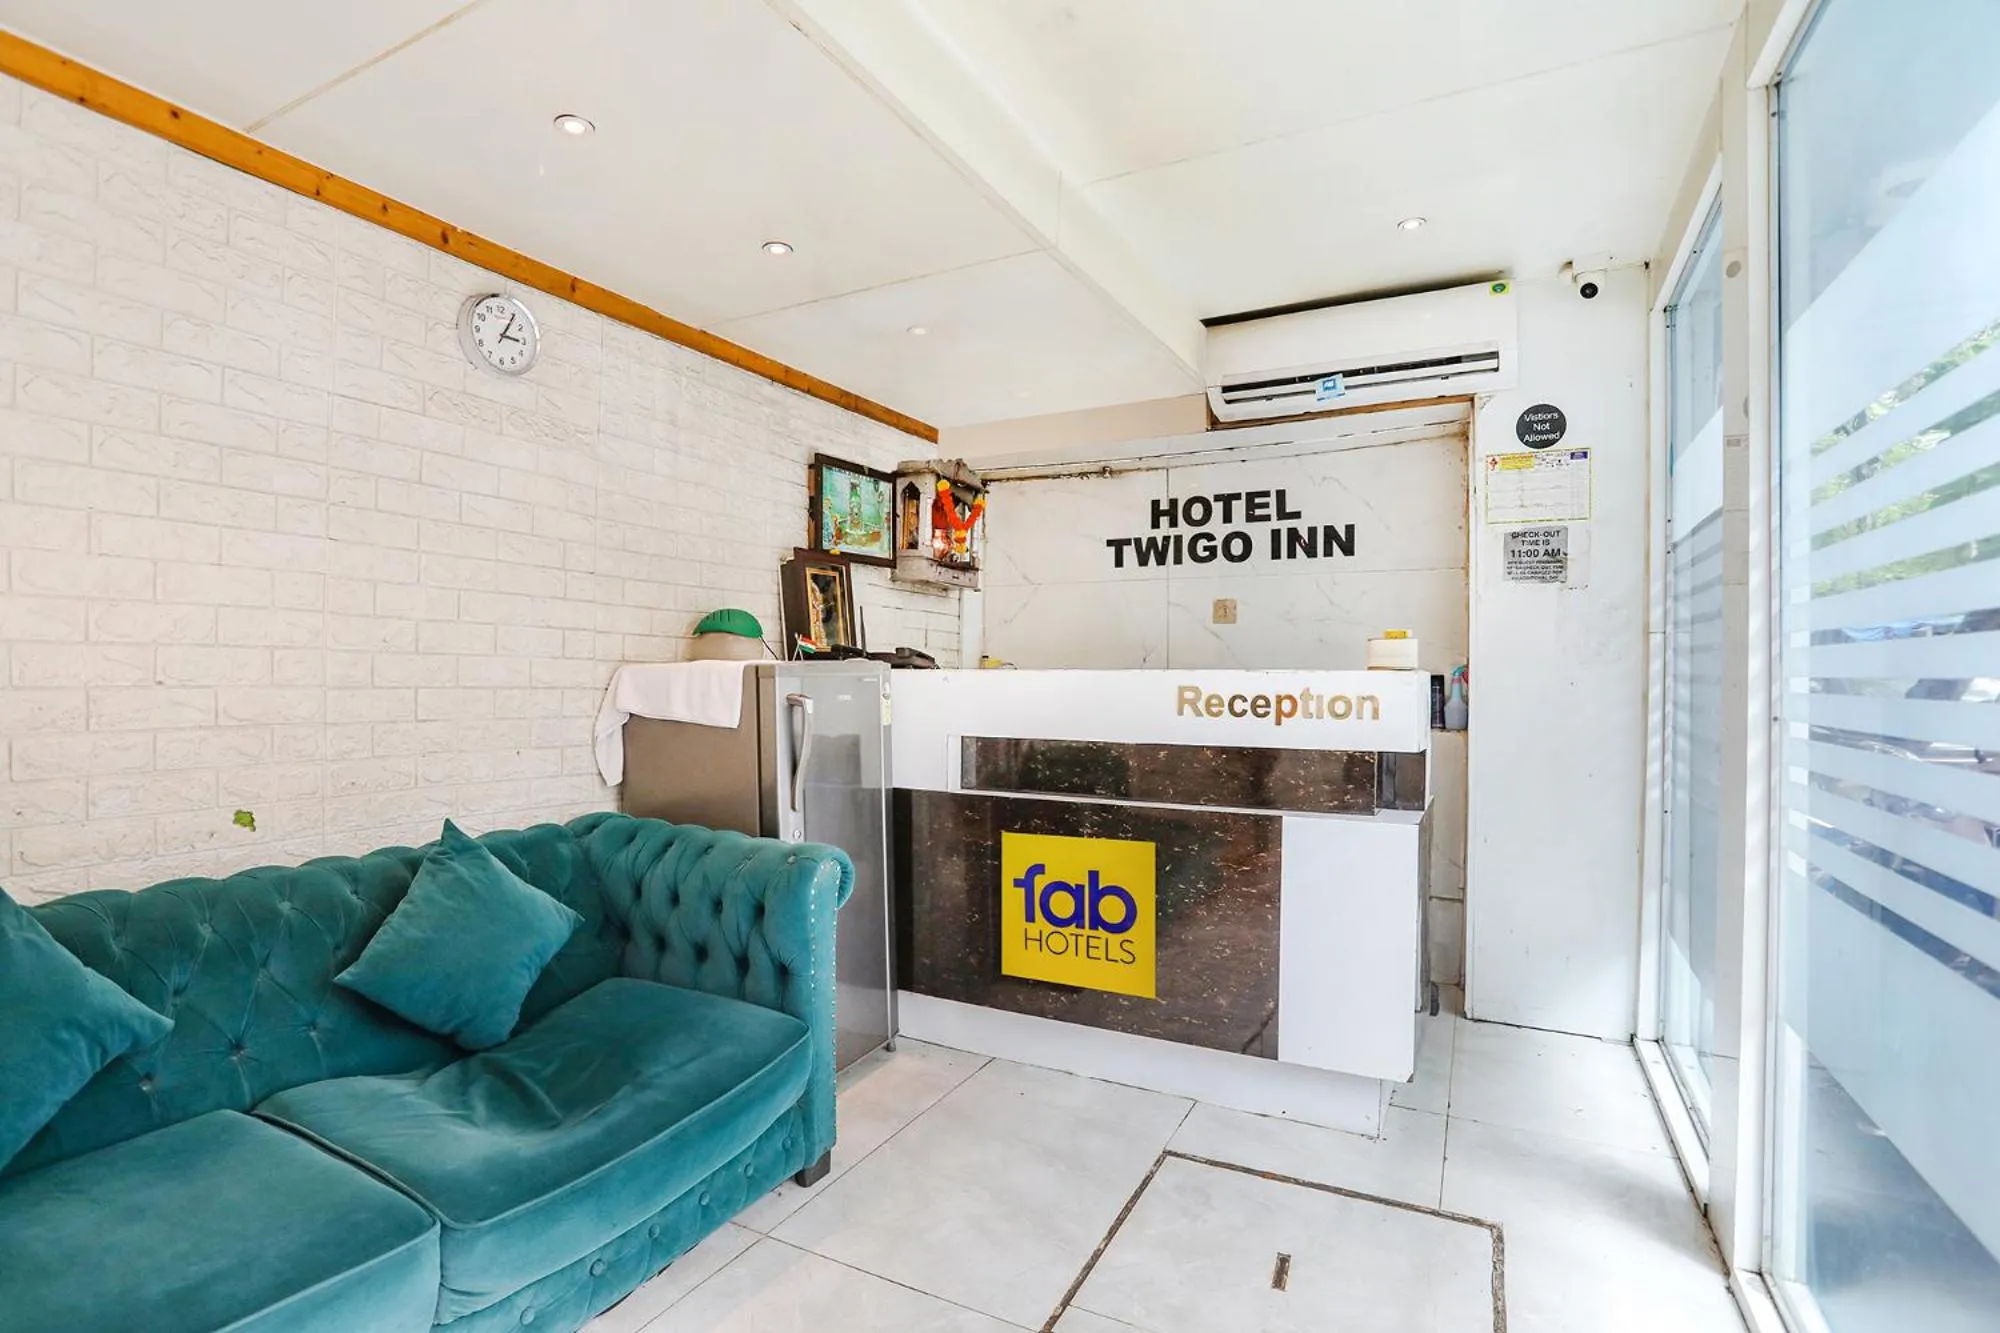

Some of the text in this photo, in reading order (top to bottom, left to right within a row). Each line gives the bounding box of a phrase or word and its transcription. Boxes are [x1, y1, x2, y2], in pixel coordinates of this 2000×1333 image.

[477, 313, 486, 321] 10
[474, 325, 480, 333] 9
[488, 350, 493, 358] 7
[499, 356, 505, 365] 6
[1533, 422, 1550, 431] Not
[1523, 431, 1560, 442] Allowed
[1151, 489, 1302, 529] HOTEL
[1511, 530, 1560, 538] CHECK-OUT
[1106, 524, 1356, 568] TWIGO INN
[1542, 538, 1550, 546] IS
[1510, 548, 1561, 558] 11:00 AM
[1177, 685, 1380, 726] Reception
[1013, 863, 1138, 935] fab
[1024, 927, 1136, 965] HOTELS
